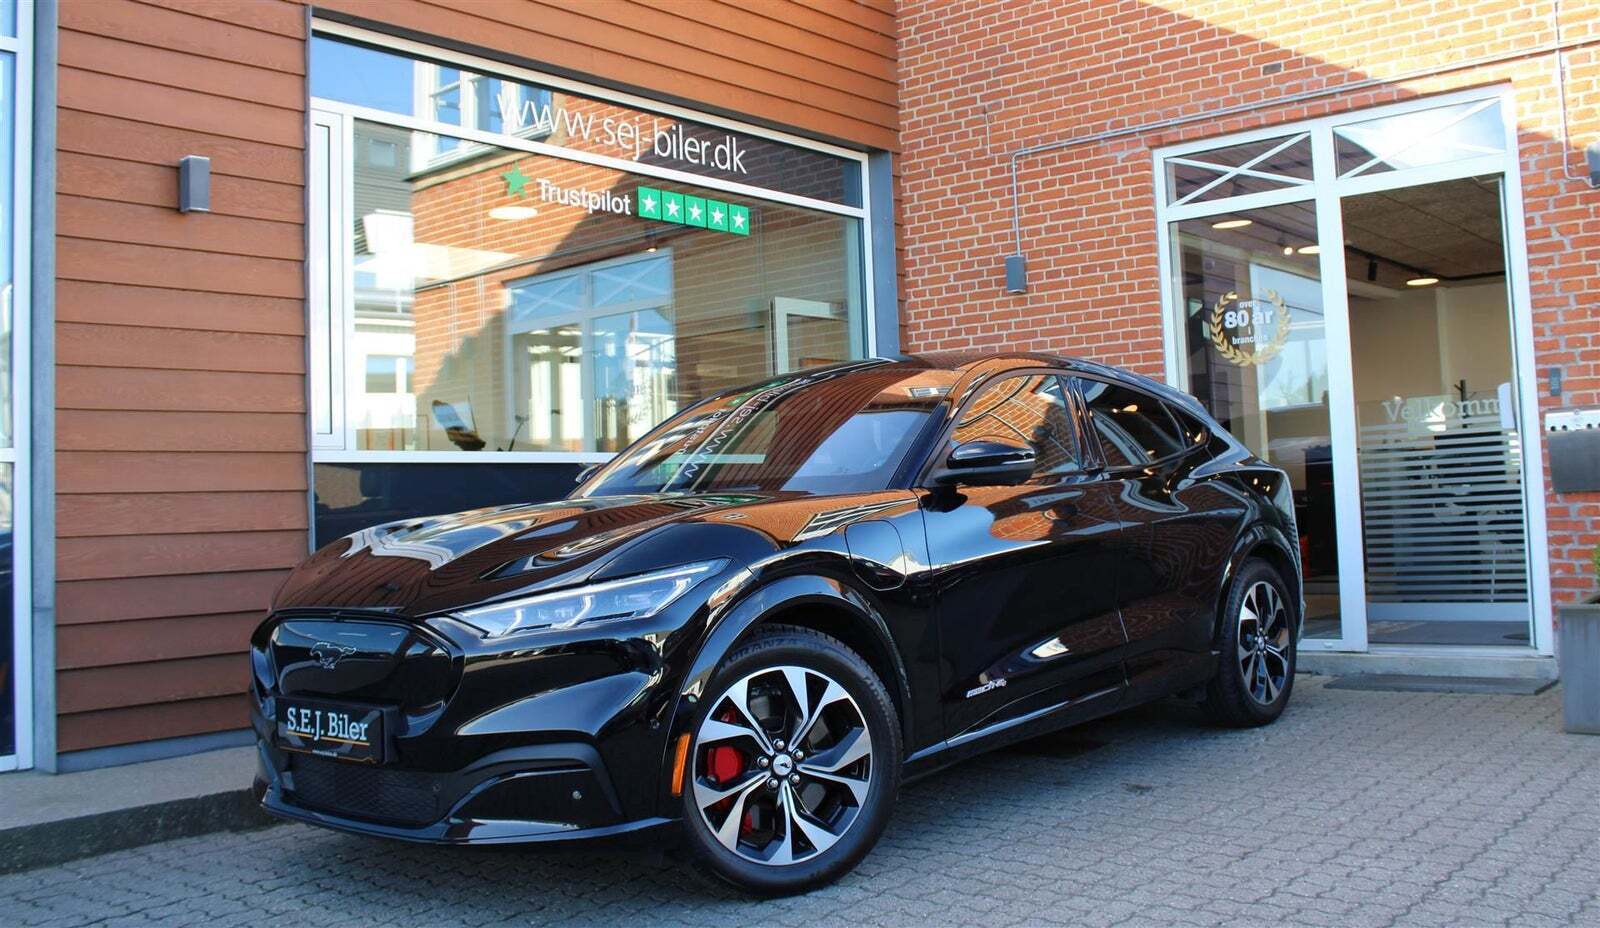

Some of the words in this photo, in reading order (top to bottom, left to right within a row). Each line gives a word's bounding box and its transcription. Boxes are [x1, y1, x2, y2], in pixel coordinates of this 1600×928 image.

[497, 93, 748, 174] www.sej-biler.dk
[536, 178, 632, 215] Trustpilot
[1224, 309, 1250, 329] 80
[286, 707, 325, 741] S.E.J.
[327, 711, 369, 741] Biler
